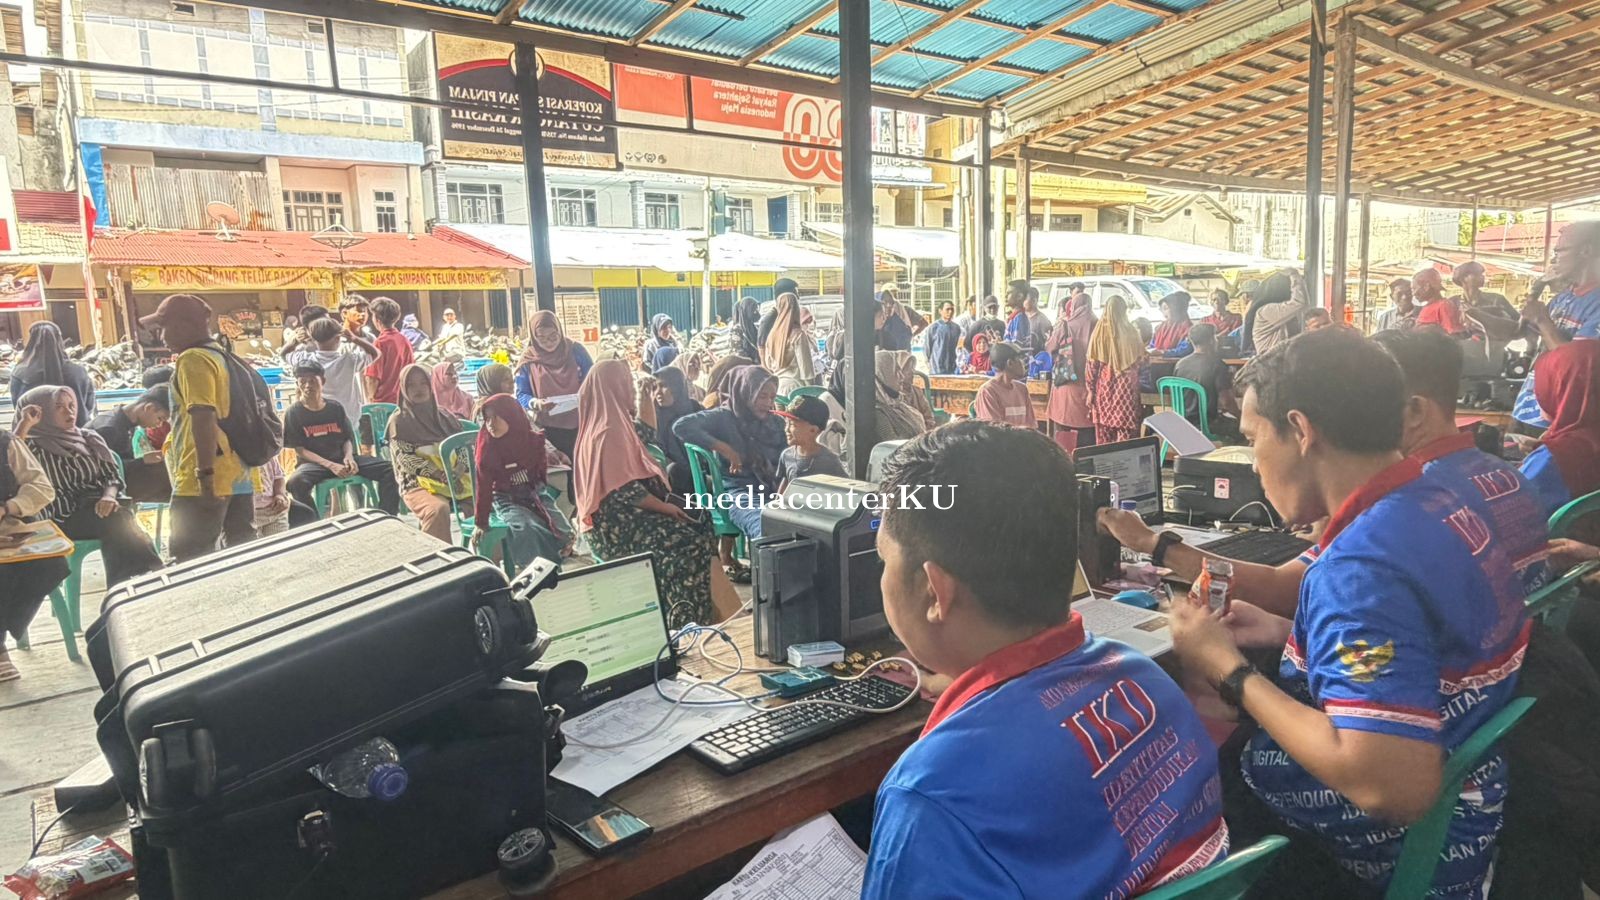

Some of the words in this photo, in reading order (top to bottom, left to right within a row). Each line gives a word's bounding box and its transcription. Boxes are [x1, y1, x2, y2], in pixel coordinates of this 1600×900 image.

[158, 269, 191, 285] BAKSO
[241, 270, 272, 284] TELUK
[370, 272, 396, 285] BAKSO
[398, 272, 431, 285] SIMPANG
[432, 272, 457, 285] TELUK
[458, 272, 485, 285] BATANG
[1060, 678, 1156, 779] IKD
